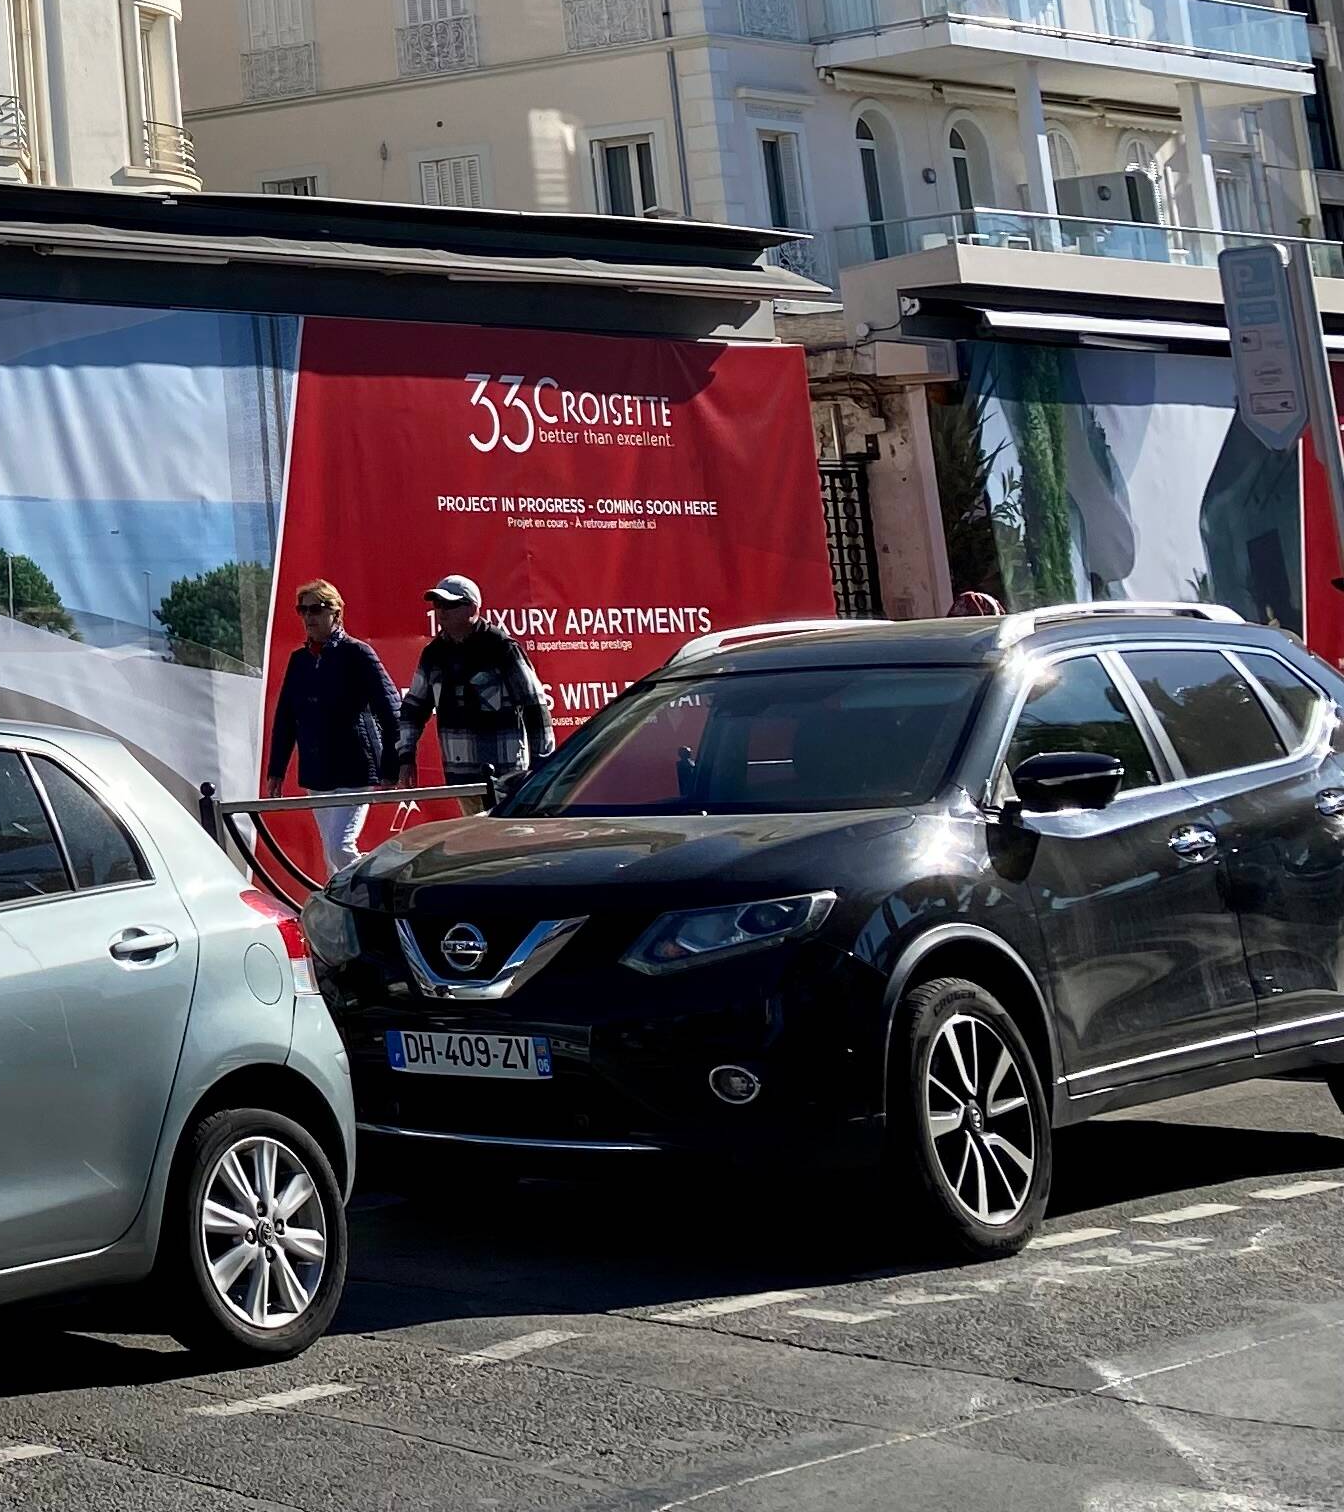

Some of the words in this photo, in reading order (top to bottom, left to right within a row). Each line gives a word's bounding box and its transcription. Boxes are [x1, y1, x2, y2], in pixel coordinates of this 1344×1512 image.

[464, 373, 535, 453] 33
[538, 427, 579, 445] better
[584, 429, 613, 445] than
[437, 495, 498, 512] PROJECT
[501, 497, 516, 512] IN
[518, 497, 586, 514] PROGRESS
[596, 498, 644, 514] COMING
[646, 500, 682, 515] SOON
[684, 500, 718, 516] HERE
[507, 516, 533, 529] Projet
[534, 518, 545, 528] en
[546, 518, 569, 528] cours
[583, 518, 618, 529] retrouver
[646, 518, 657, 529] ici
[564, 607, 712, 635] APARTMENTS
[526, 640, 535, 651] 18
[537, 639, 588, 652] appartements
[590, 639, 600, 650] de
[601, 639, 632, 652] prestige
[560, 682, 618, 710] WITH
[403, 1033, 529, 1069] DH-409-ZV
[537, 1058, 550, 1073] 06
